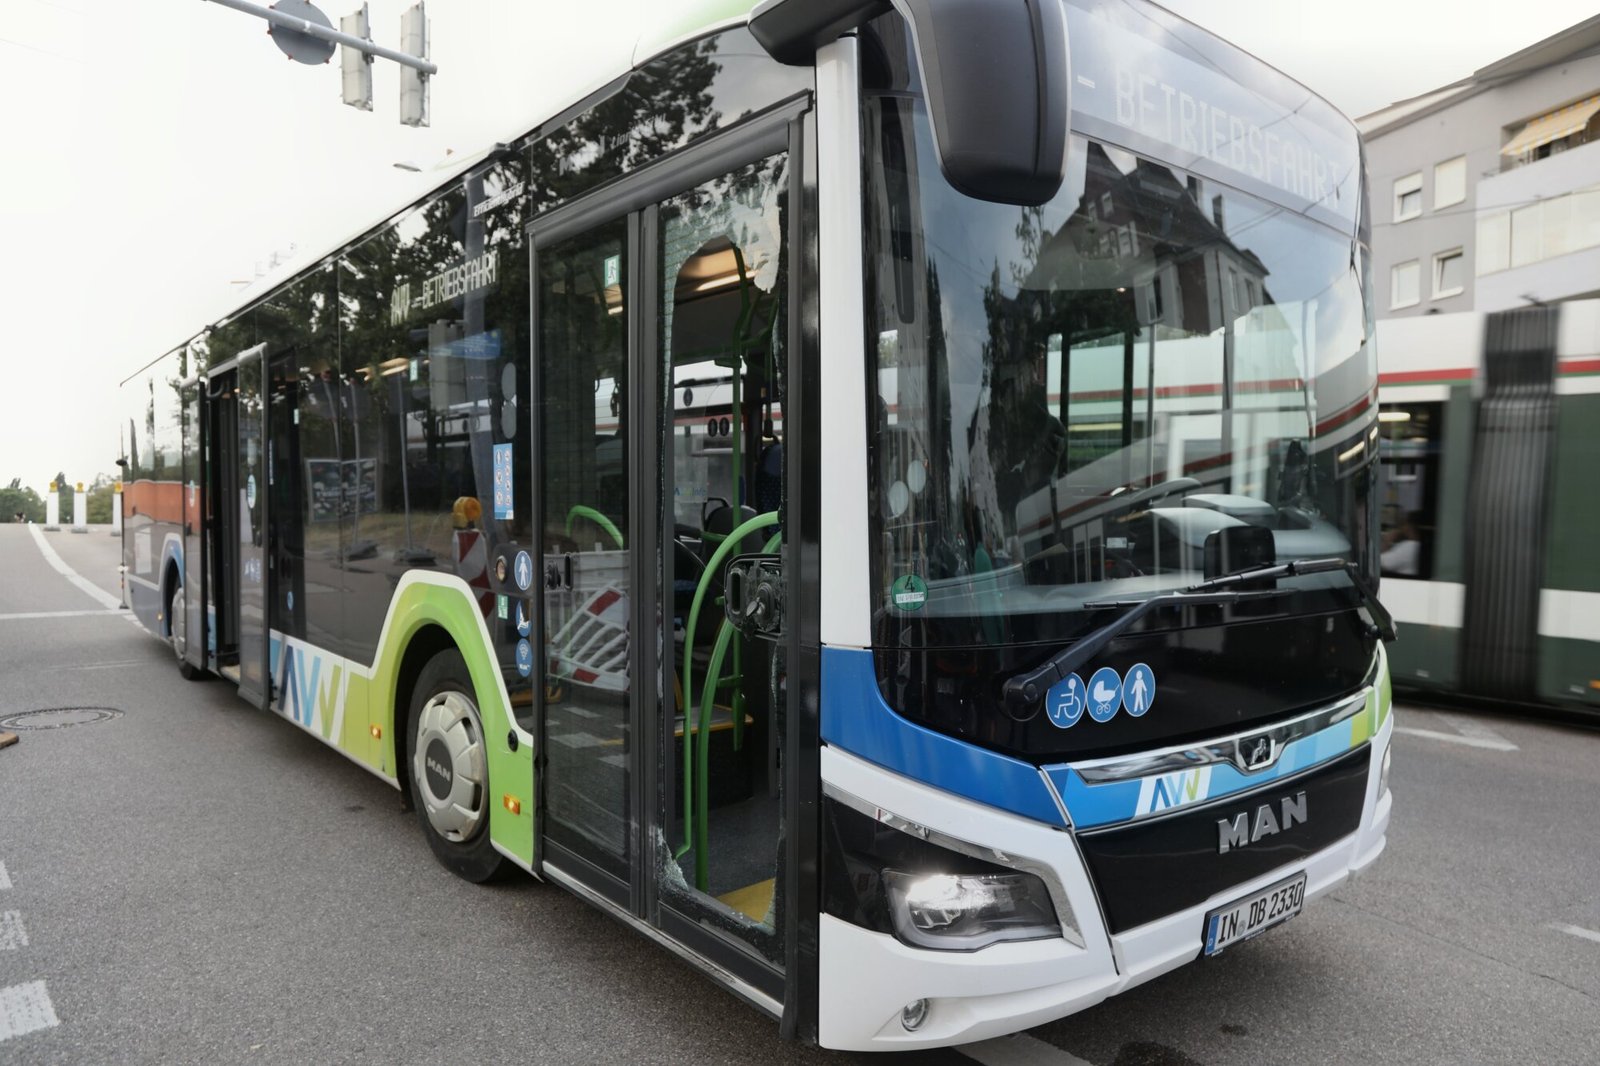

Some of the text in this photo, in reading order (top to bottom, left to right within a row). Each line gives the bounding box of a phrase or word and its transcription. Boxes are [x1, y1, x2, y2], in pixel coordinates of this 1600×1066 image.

[1115, 69, 1340, 209] BETRIEBSFAHRT
[422, 250, 498, 309] BETRIEBSFAHRT
[904, 575, 916, 592] 4
[426, 756, 451, 783] MAN
[1217, 790, 1309, 855] MAN
[1218, 909, 1240, 945] IN
[1247, 897, 1267, 930] DB
[1268, 881, 1304, 920] 2330
